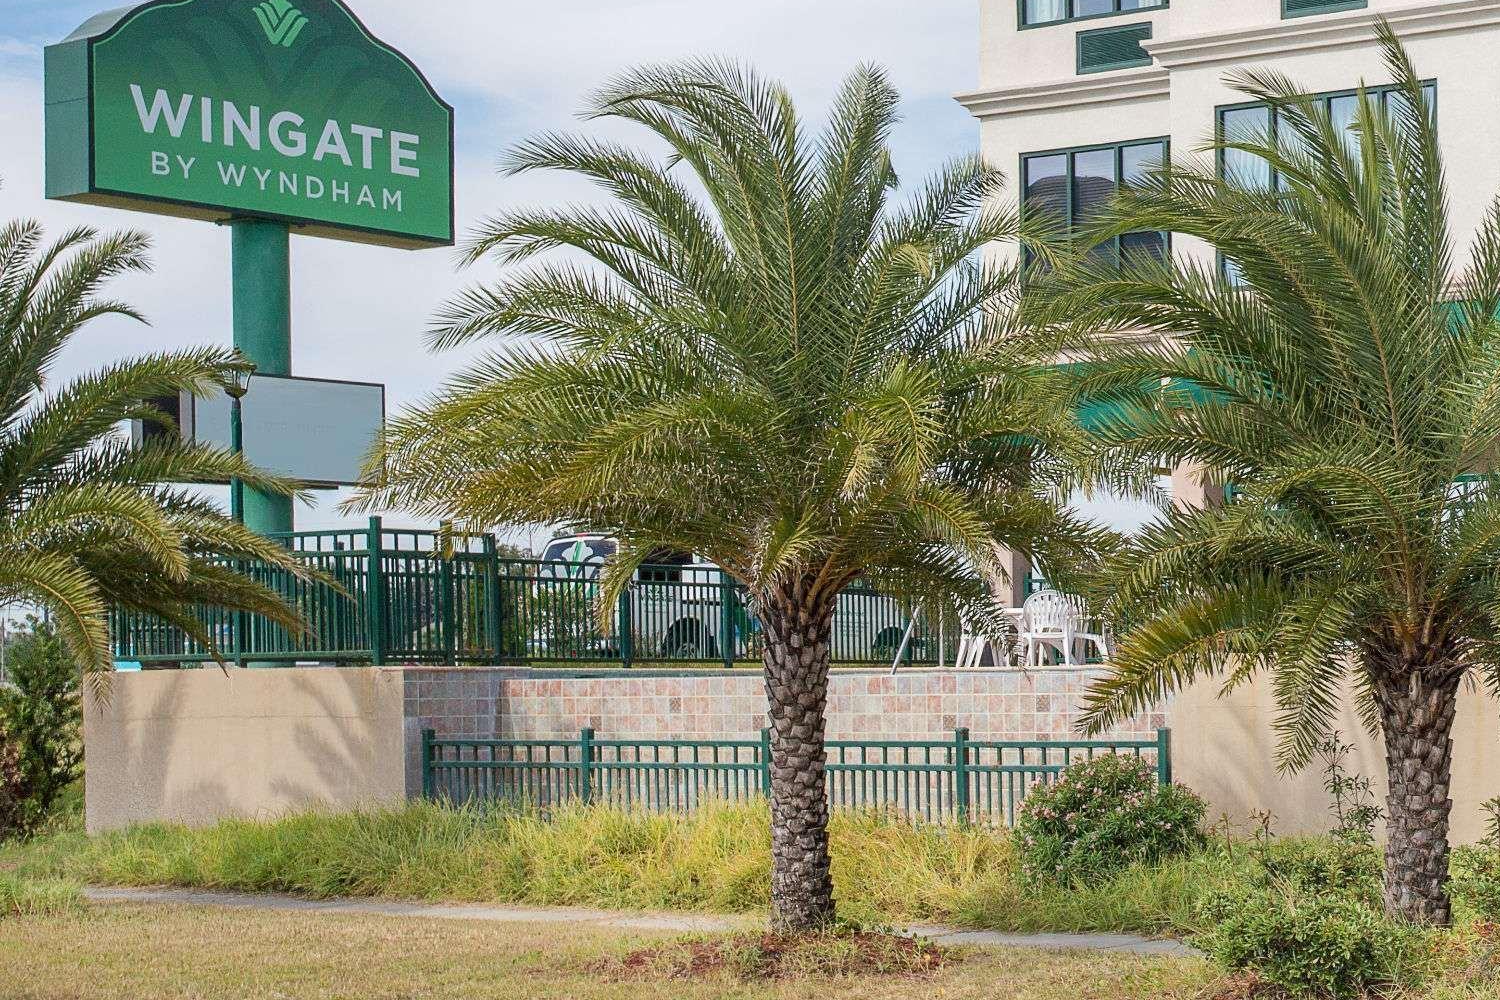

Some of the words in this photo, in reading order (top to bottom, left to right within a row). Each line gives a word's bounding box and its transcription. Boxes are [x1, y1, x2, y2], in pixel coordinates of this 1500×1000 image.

[129, 83, 420, 178] WINGATE
[151, 151, 196, 179] BY
[217, 161, 402, 212] WYNDHAM
